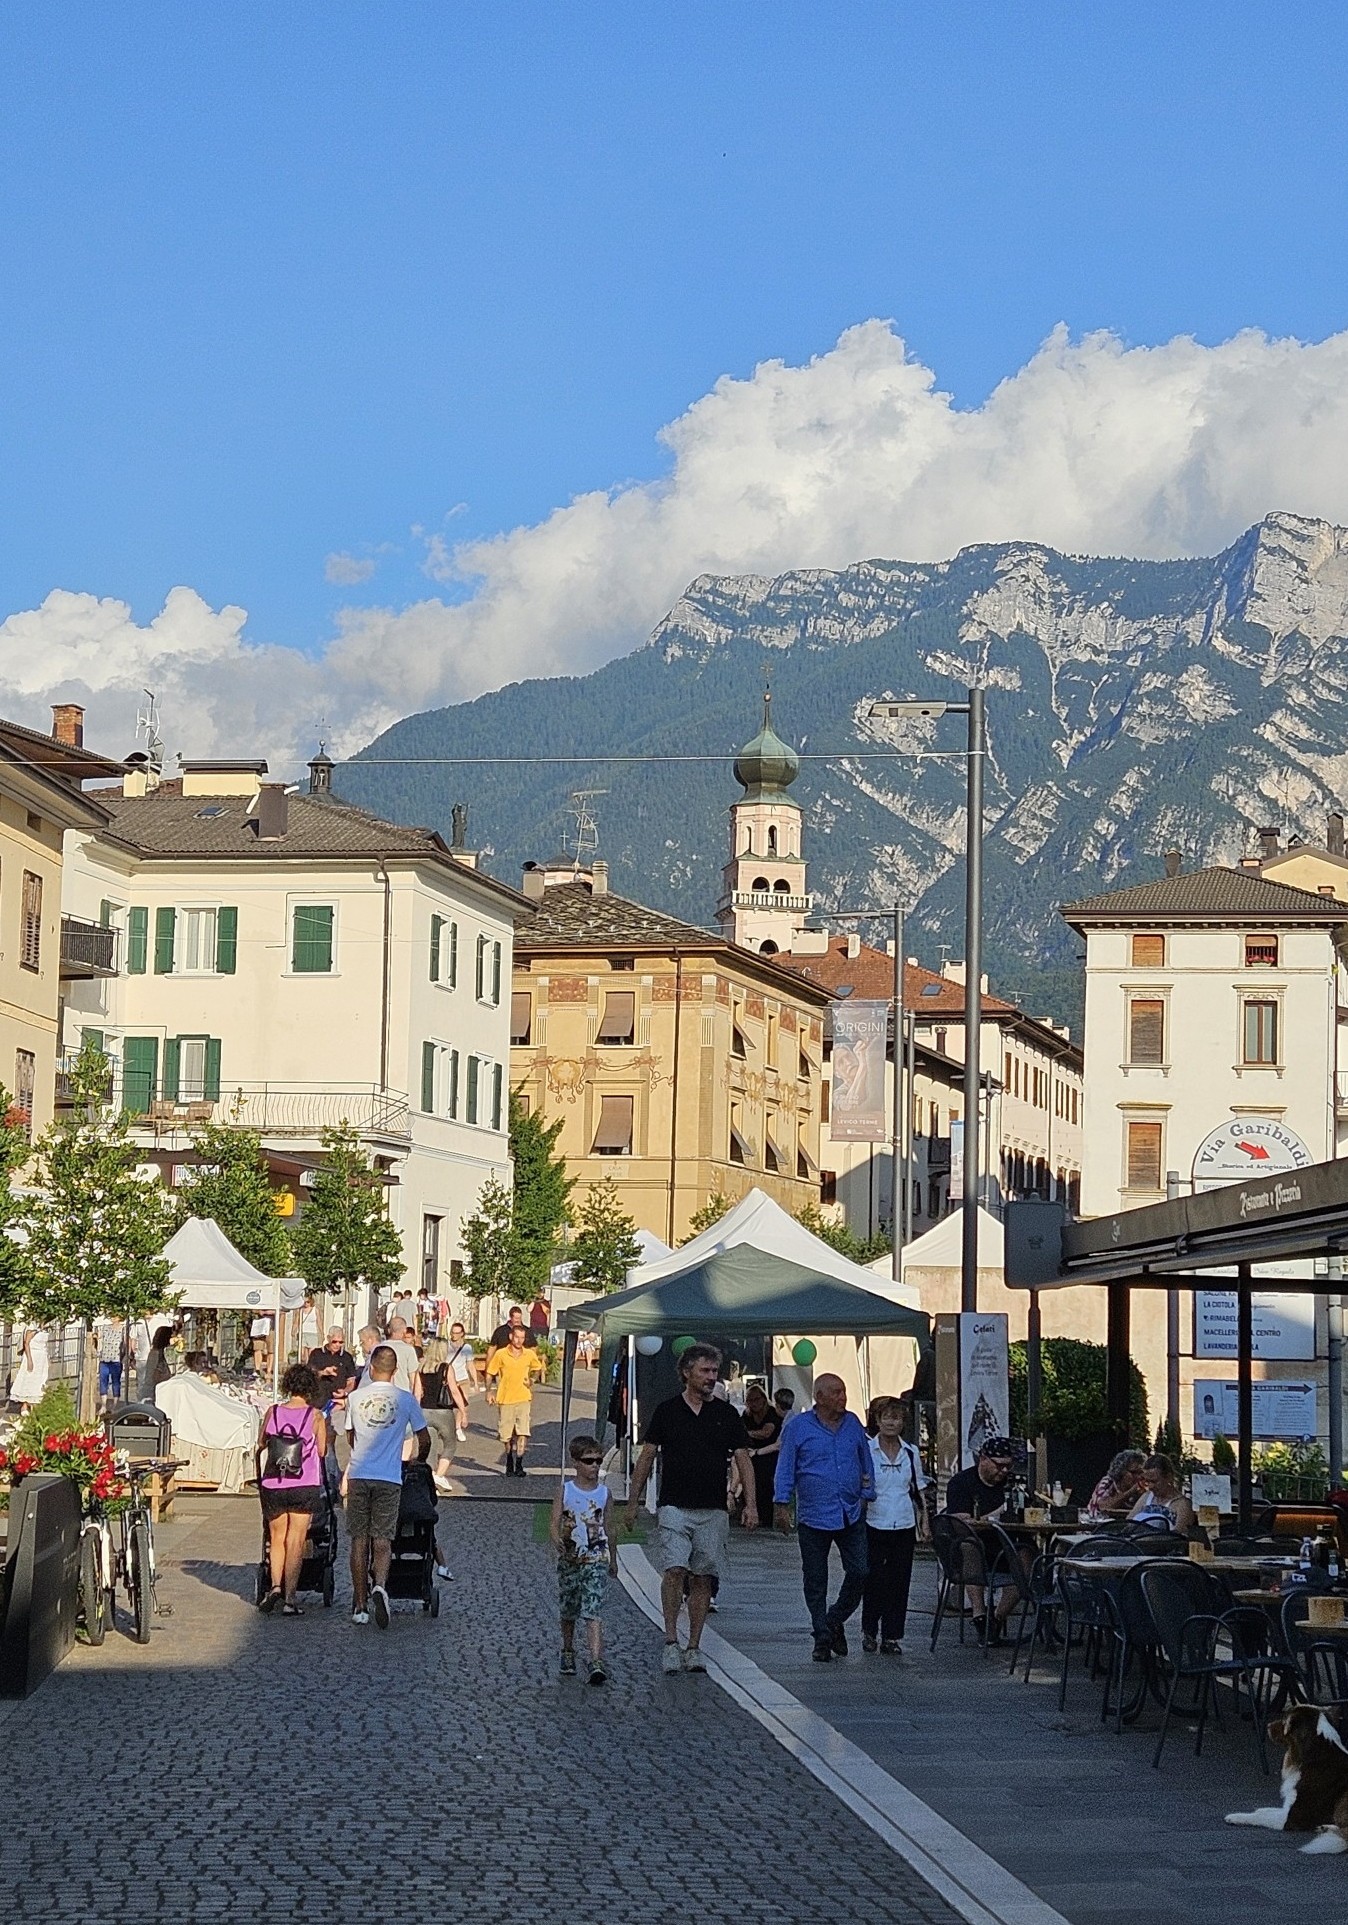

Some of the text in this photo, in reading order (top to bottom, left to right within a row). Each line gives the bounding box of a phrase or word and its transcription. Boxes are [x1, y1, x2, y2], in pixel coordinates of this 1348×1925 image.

[836, 1022, 884, 1033] ORIGINI
[1200, 1123, 1309, 1167] Via Garibaldi
